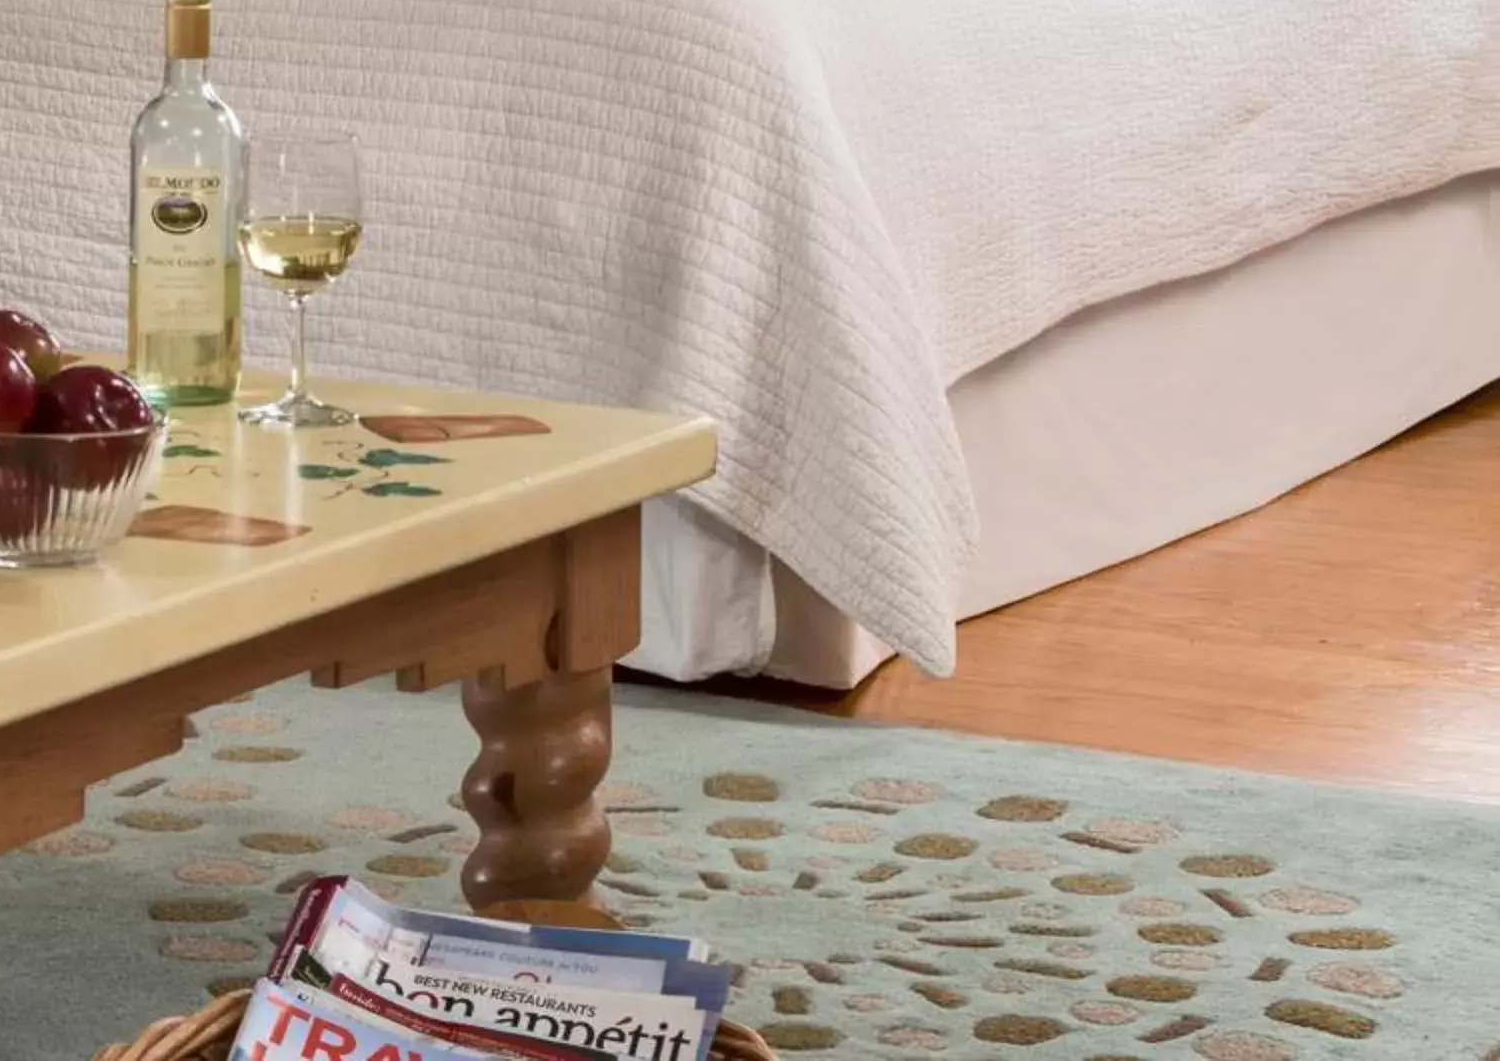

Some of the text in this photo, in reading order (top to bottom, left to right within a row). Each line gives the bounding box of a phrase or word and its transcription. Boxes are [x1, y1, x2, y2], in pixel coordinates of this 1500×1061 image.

[414, 974, 598, 1018] BEST NEW RESTAURANTS
[266, 990, 421, 1061] TR
